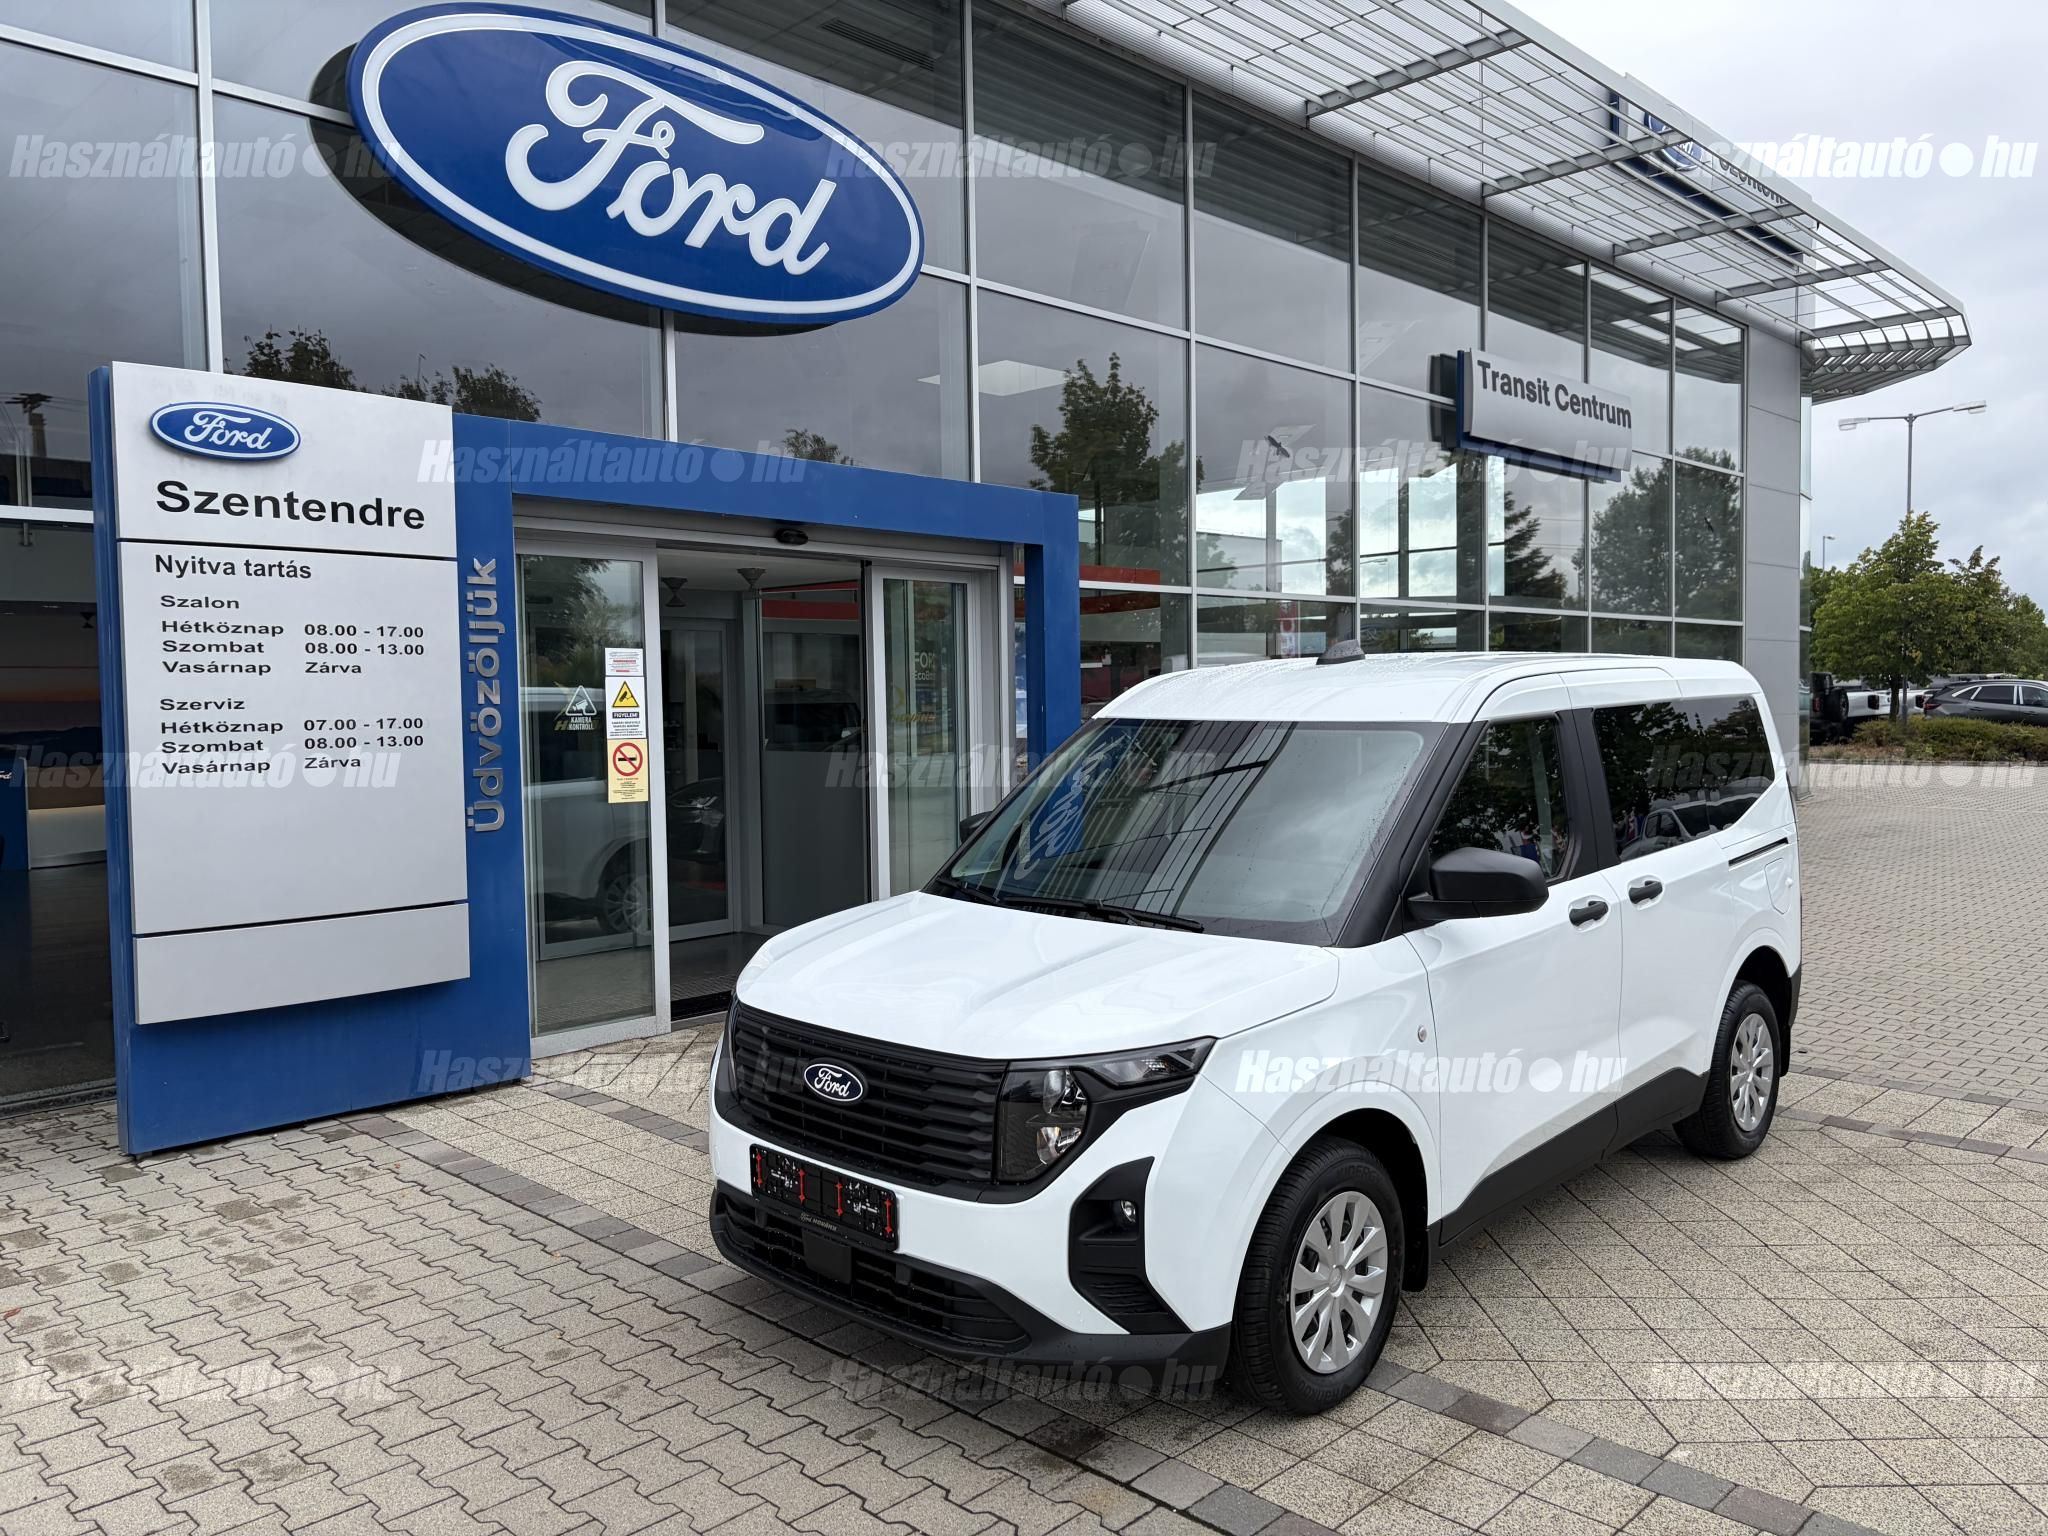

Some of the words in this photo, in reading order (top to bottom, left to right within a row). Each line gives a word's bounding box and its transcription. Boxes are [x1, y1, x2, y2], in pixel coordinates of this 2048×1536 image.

[505, 60, 837, 275] Ford
[1477, 359, 1550, 407] Transit
[1555, 383, 1632, 429] Centrum
[184, 410, 273, 451] Ford
[156, 480, 425, 530] Szentendre
[155, 554, 236, 578] Nyitva
[244, 560, 312, 579] tartás
[160, 595, 240, 609] Szalon
[161, 620, 284, 637] Hétköznap
[304, 624, 357, 637] 08.00
[376, 626, 424, 638] 17.00
[162, 640, 264, 653] Szombat
[304, 642, 358, 655] 08.00
[377, 643, 425, 656] 13.00
[162, 660, 271, 676] Vasárnap
[305, 661, 362, 674] Zárva
[466, 557, 506, 832] Üdvözöljük
[159, 698, 246, 711] Szerviz
[161, 721, 283, 735] Hétköznap
[303, 719, 357, 731] 07.00
[376, 717, 424, 730] 17.00
[161, 739, 264, 753] Szombat
[304, 737, 357, 750] 08.00
[376, 735, 424, 748] 13.00
[161, 761, 271, 774] Vasárnap
[304, 757, 361, 769] Zárva
[814, 1067, 851, 1097] Ford
